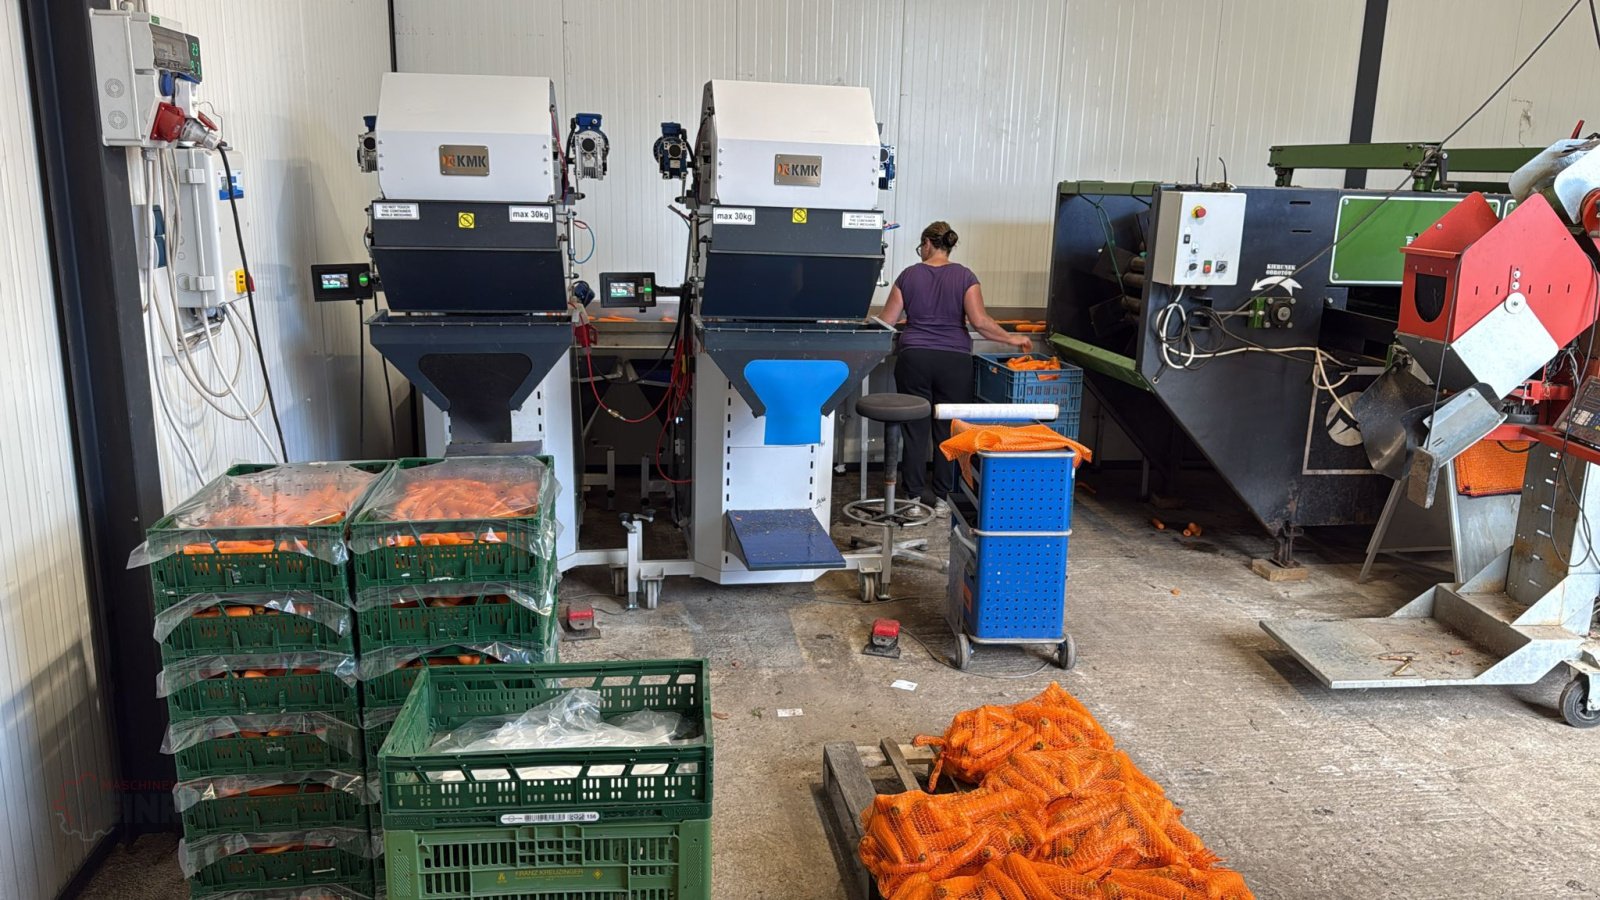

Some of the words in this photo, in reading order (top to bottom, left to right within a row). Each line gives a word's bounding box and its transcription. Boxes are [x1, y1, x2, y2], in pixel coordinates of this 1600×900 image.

[457, 155, 487, 168] KMK
[791, 164, 819, 177] KMK
[530, 210, 549, 220] 30kg
[734, 212, 752, 222] 30kg
